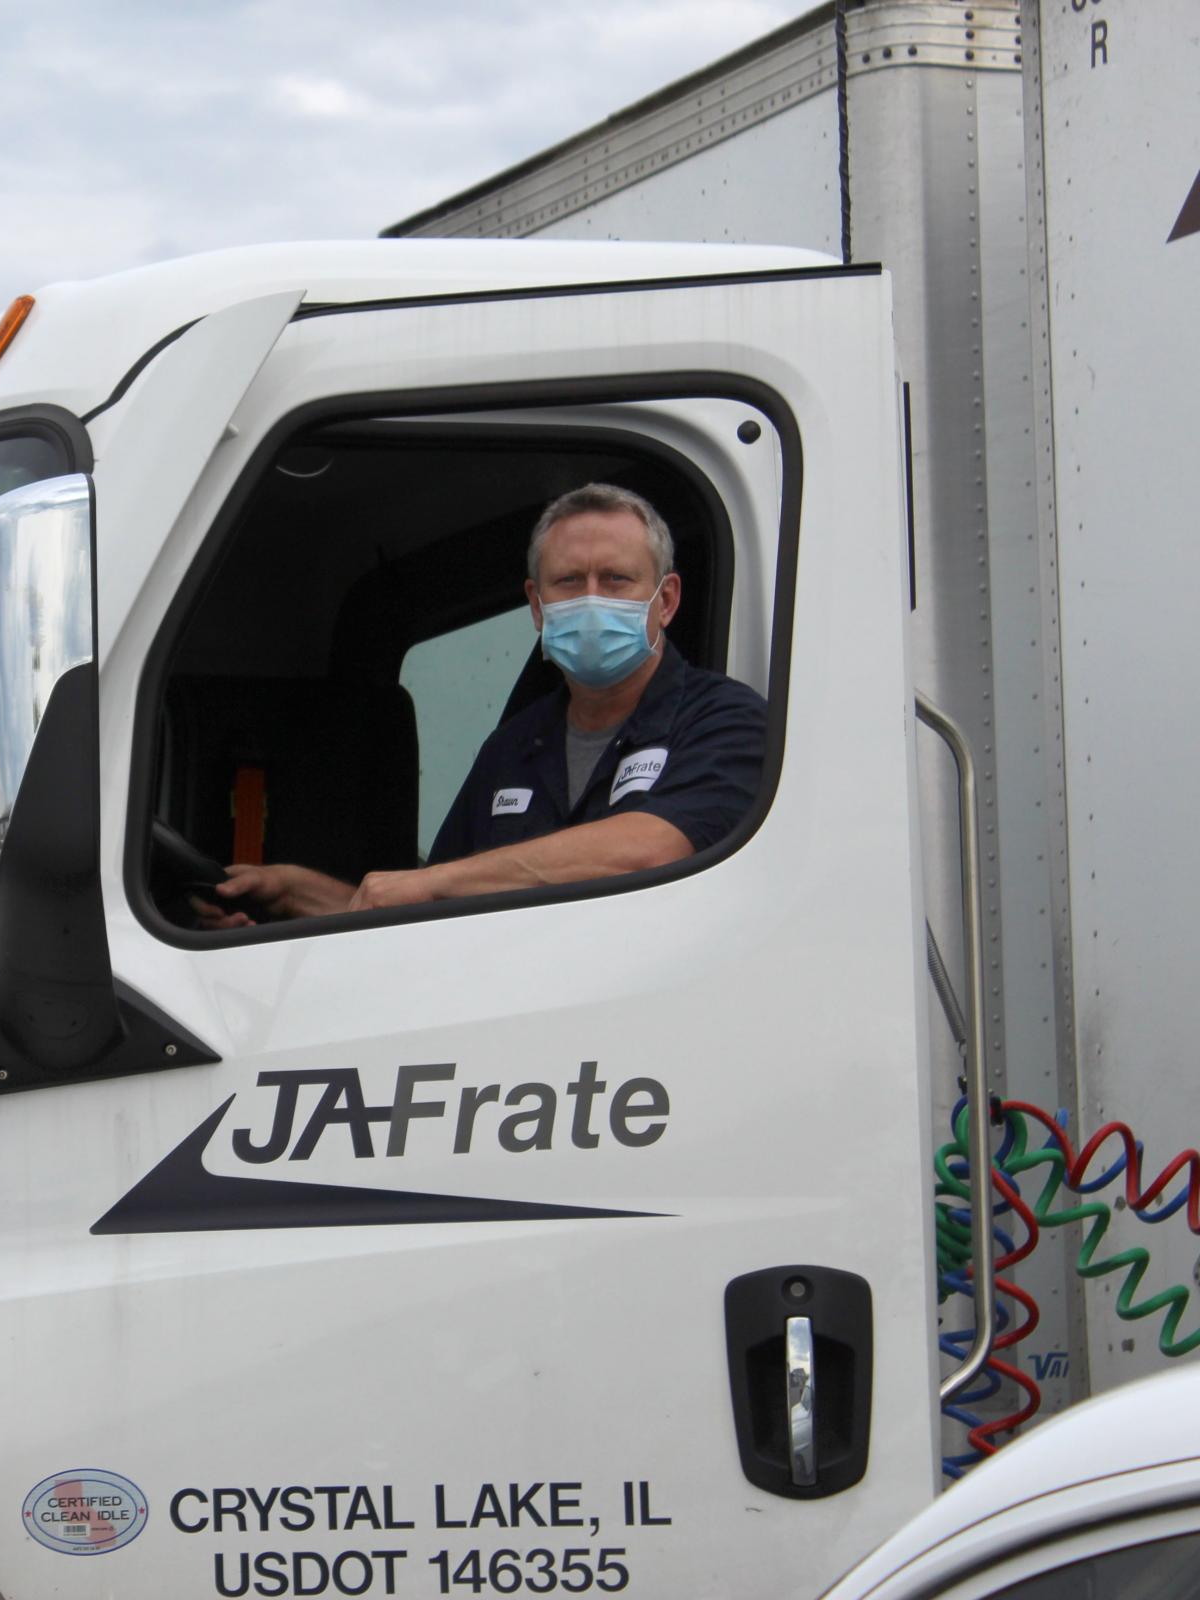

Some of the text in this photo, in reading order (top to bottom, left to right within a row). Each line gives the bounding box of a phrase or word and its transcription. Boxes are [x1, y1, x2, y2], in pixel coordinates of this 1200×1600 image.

[1091, 20, 1108, 68] R
[232, 1060, 670, 1165] JAFrate
[40, 1509, 130, 1523] CLEAN IDLE
[47, 1496, 122, 1508] CERTIFIED
[169, 1481, 672, 1536] CRYSTAL LAKE, IL
[214, 1548, 630, 1597] USDOT 146355
